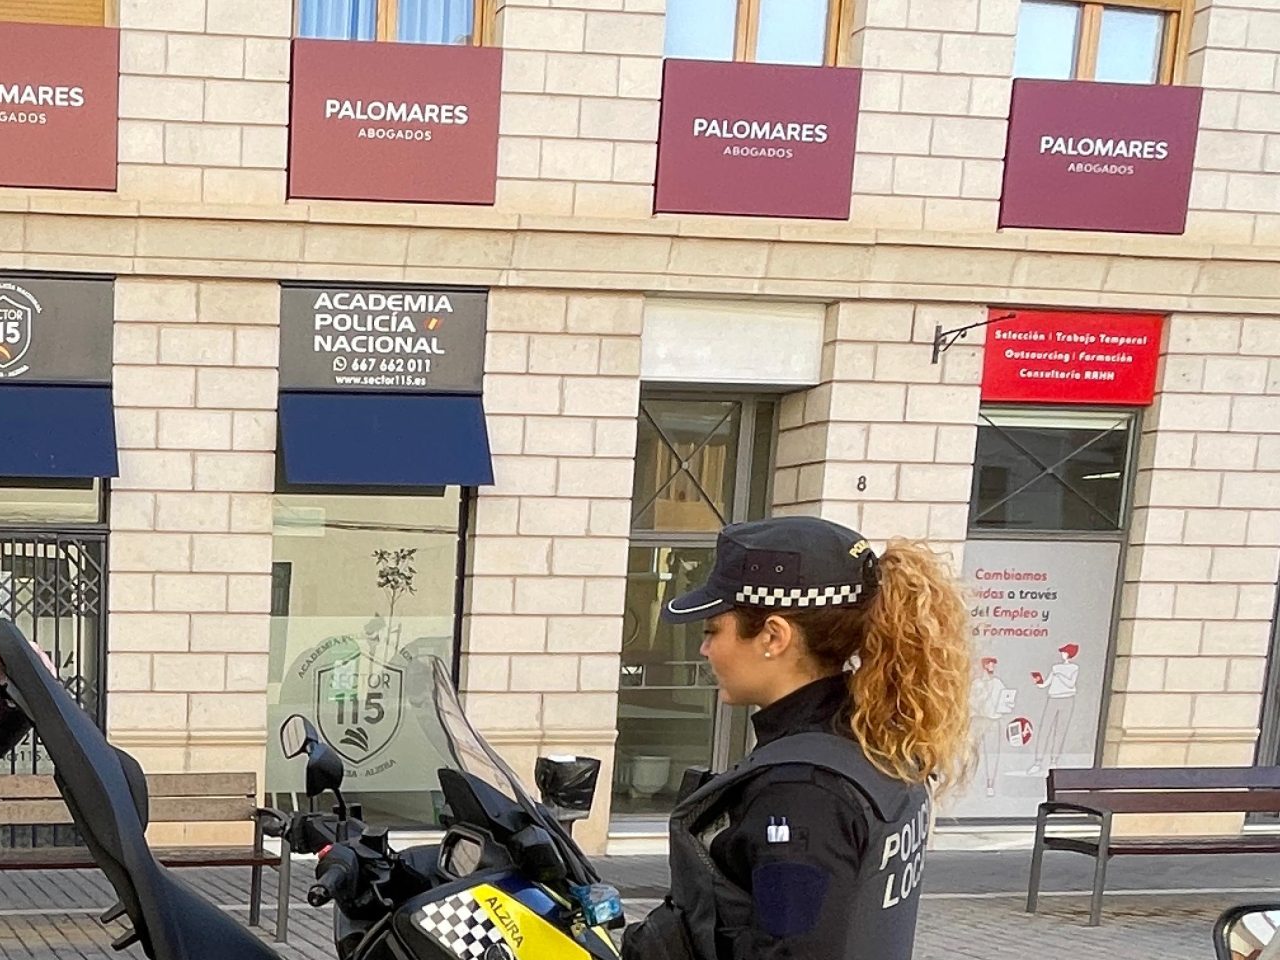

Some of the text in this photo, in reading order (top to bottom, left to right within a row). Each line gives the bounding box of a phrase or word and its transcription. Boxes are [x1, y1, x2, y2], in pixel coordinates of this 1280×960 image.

[325, 99, 469, 125] PALOMARES
[357, 128, 432, 141] ABOGADOS
[693, 118, 828, 143] PALOMARES
[722, 146, 794, 159] ABOGADOS
[1040, 136, 1168, 160] PALOMARES
[1067, 162, 1134, 175] ABOGADOS
[314, 292, 454, 313] ACADEMIA
[314, 312, 417, 333] POLICÍA
[313, 334, 445, 354] NACIONAL
[995, 330, 1148, 346] Selección Trabajo Temporal
[1005, 349, 1133, 363] Outsourcing Formación
[351, 358, 431, 373] 667 662 011
[335, 375, 426, 386] www.sector115.es
[856, 475, 866, 492] 8
[975, 568, 1048, 581] Cambiamos
[1007, 590, 1015, 600] a
[1019, 587, 1058, 600] través
[970, 605, 1050, 622] del Empleo y
[982, 624, 1048, 637] Formación
[335, 692, 385, 725] 115
[485, 896, 524, 949] ALZIRA
